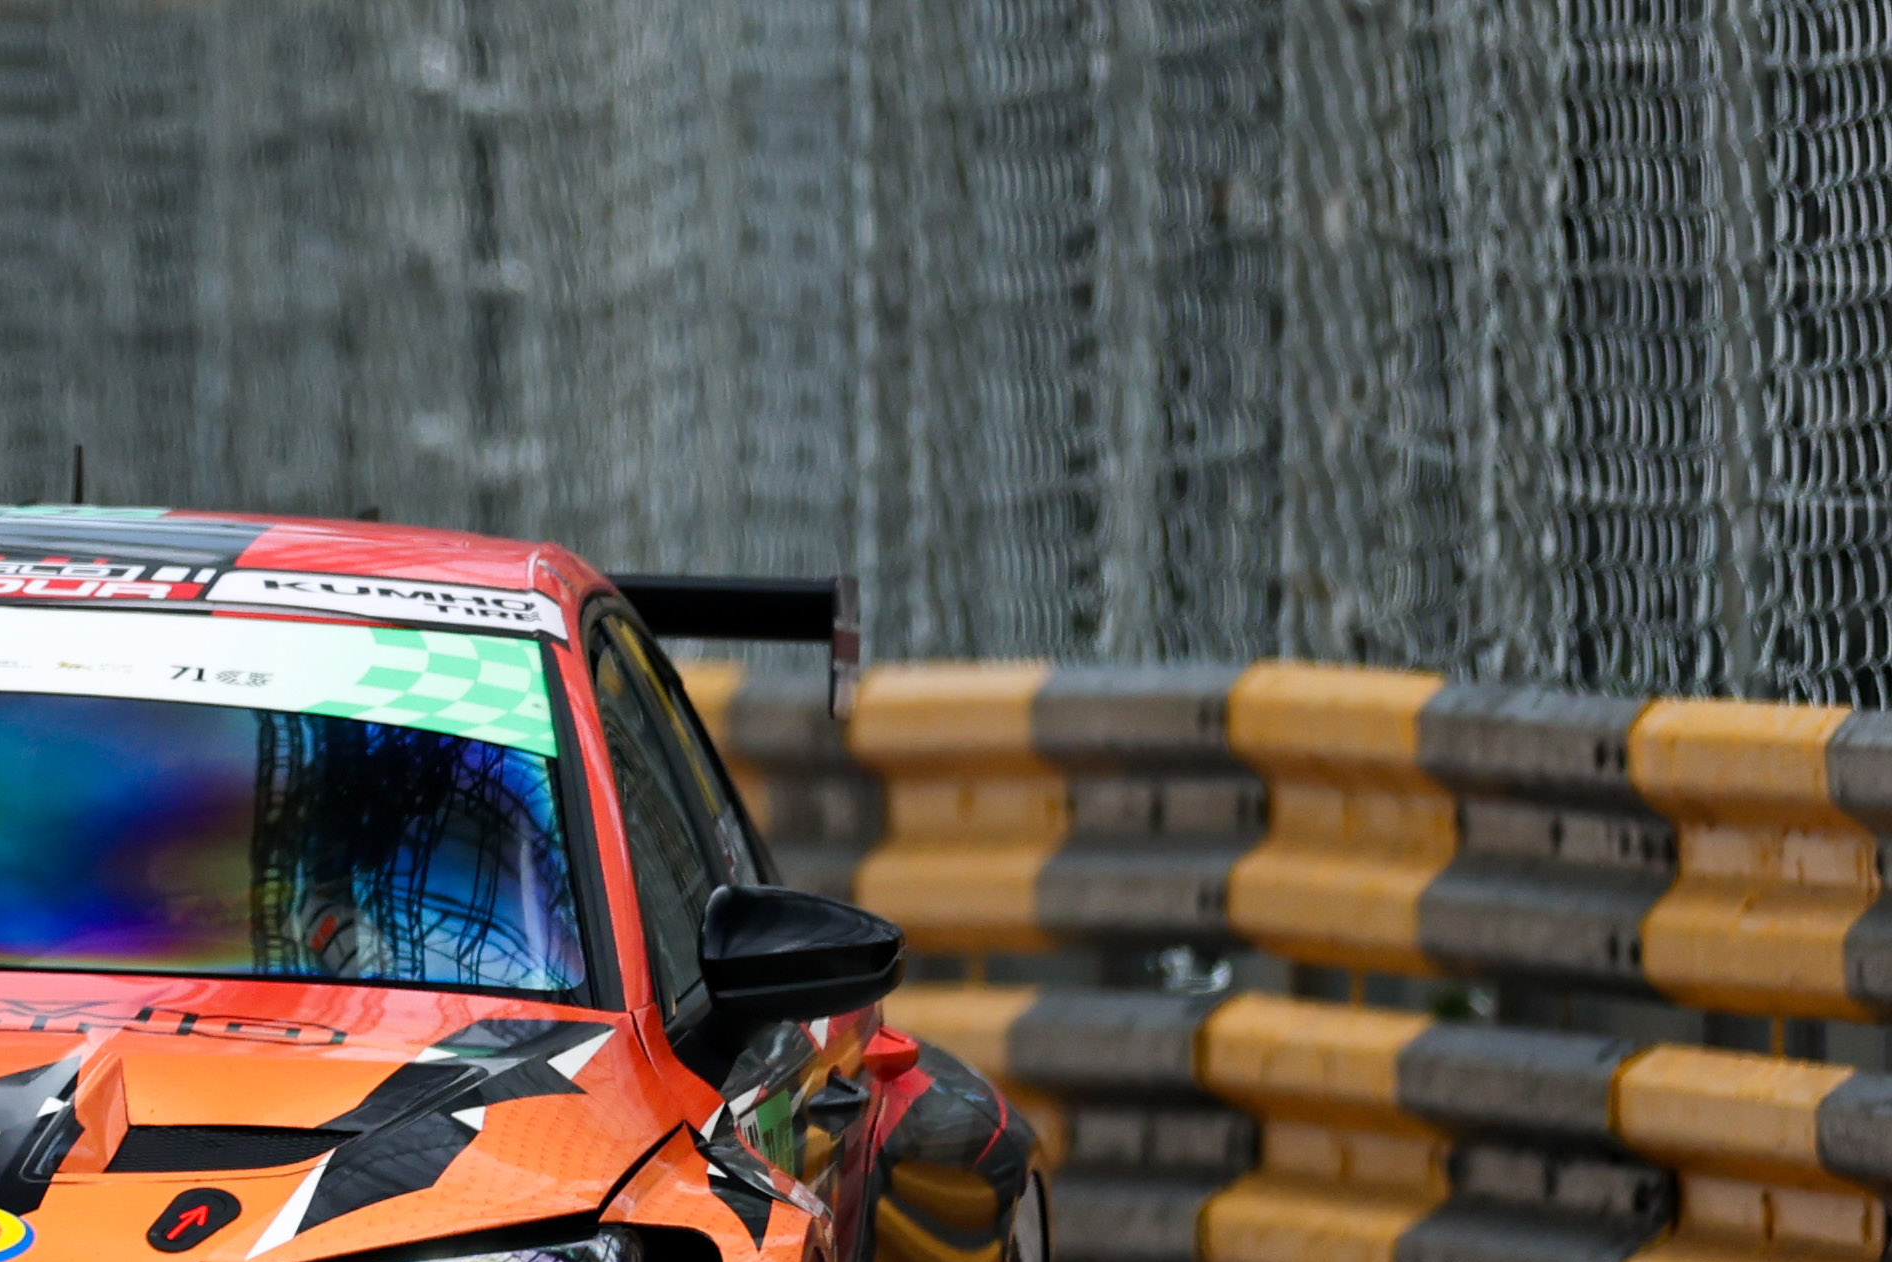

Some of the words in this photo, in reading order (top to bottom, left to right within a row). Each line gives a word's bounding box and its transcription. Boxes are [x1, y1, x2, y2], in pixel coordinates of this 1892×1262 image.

[263, 579, 536, 611] KUMHO
[424, 602, 543, 622] TIRE
[170, 664, 208, 682] 71
